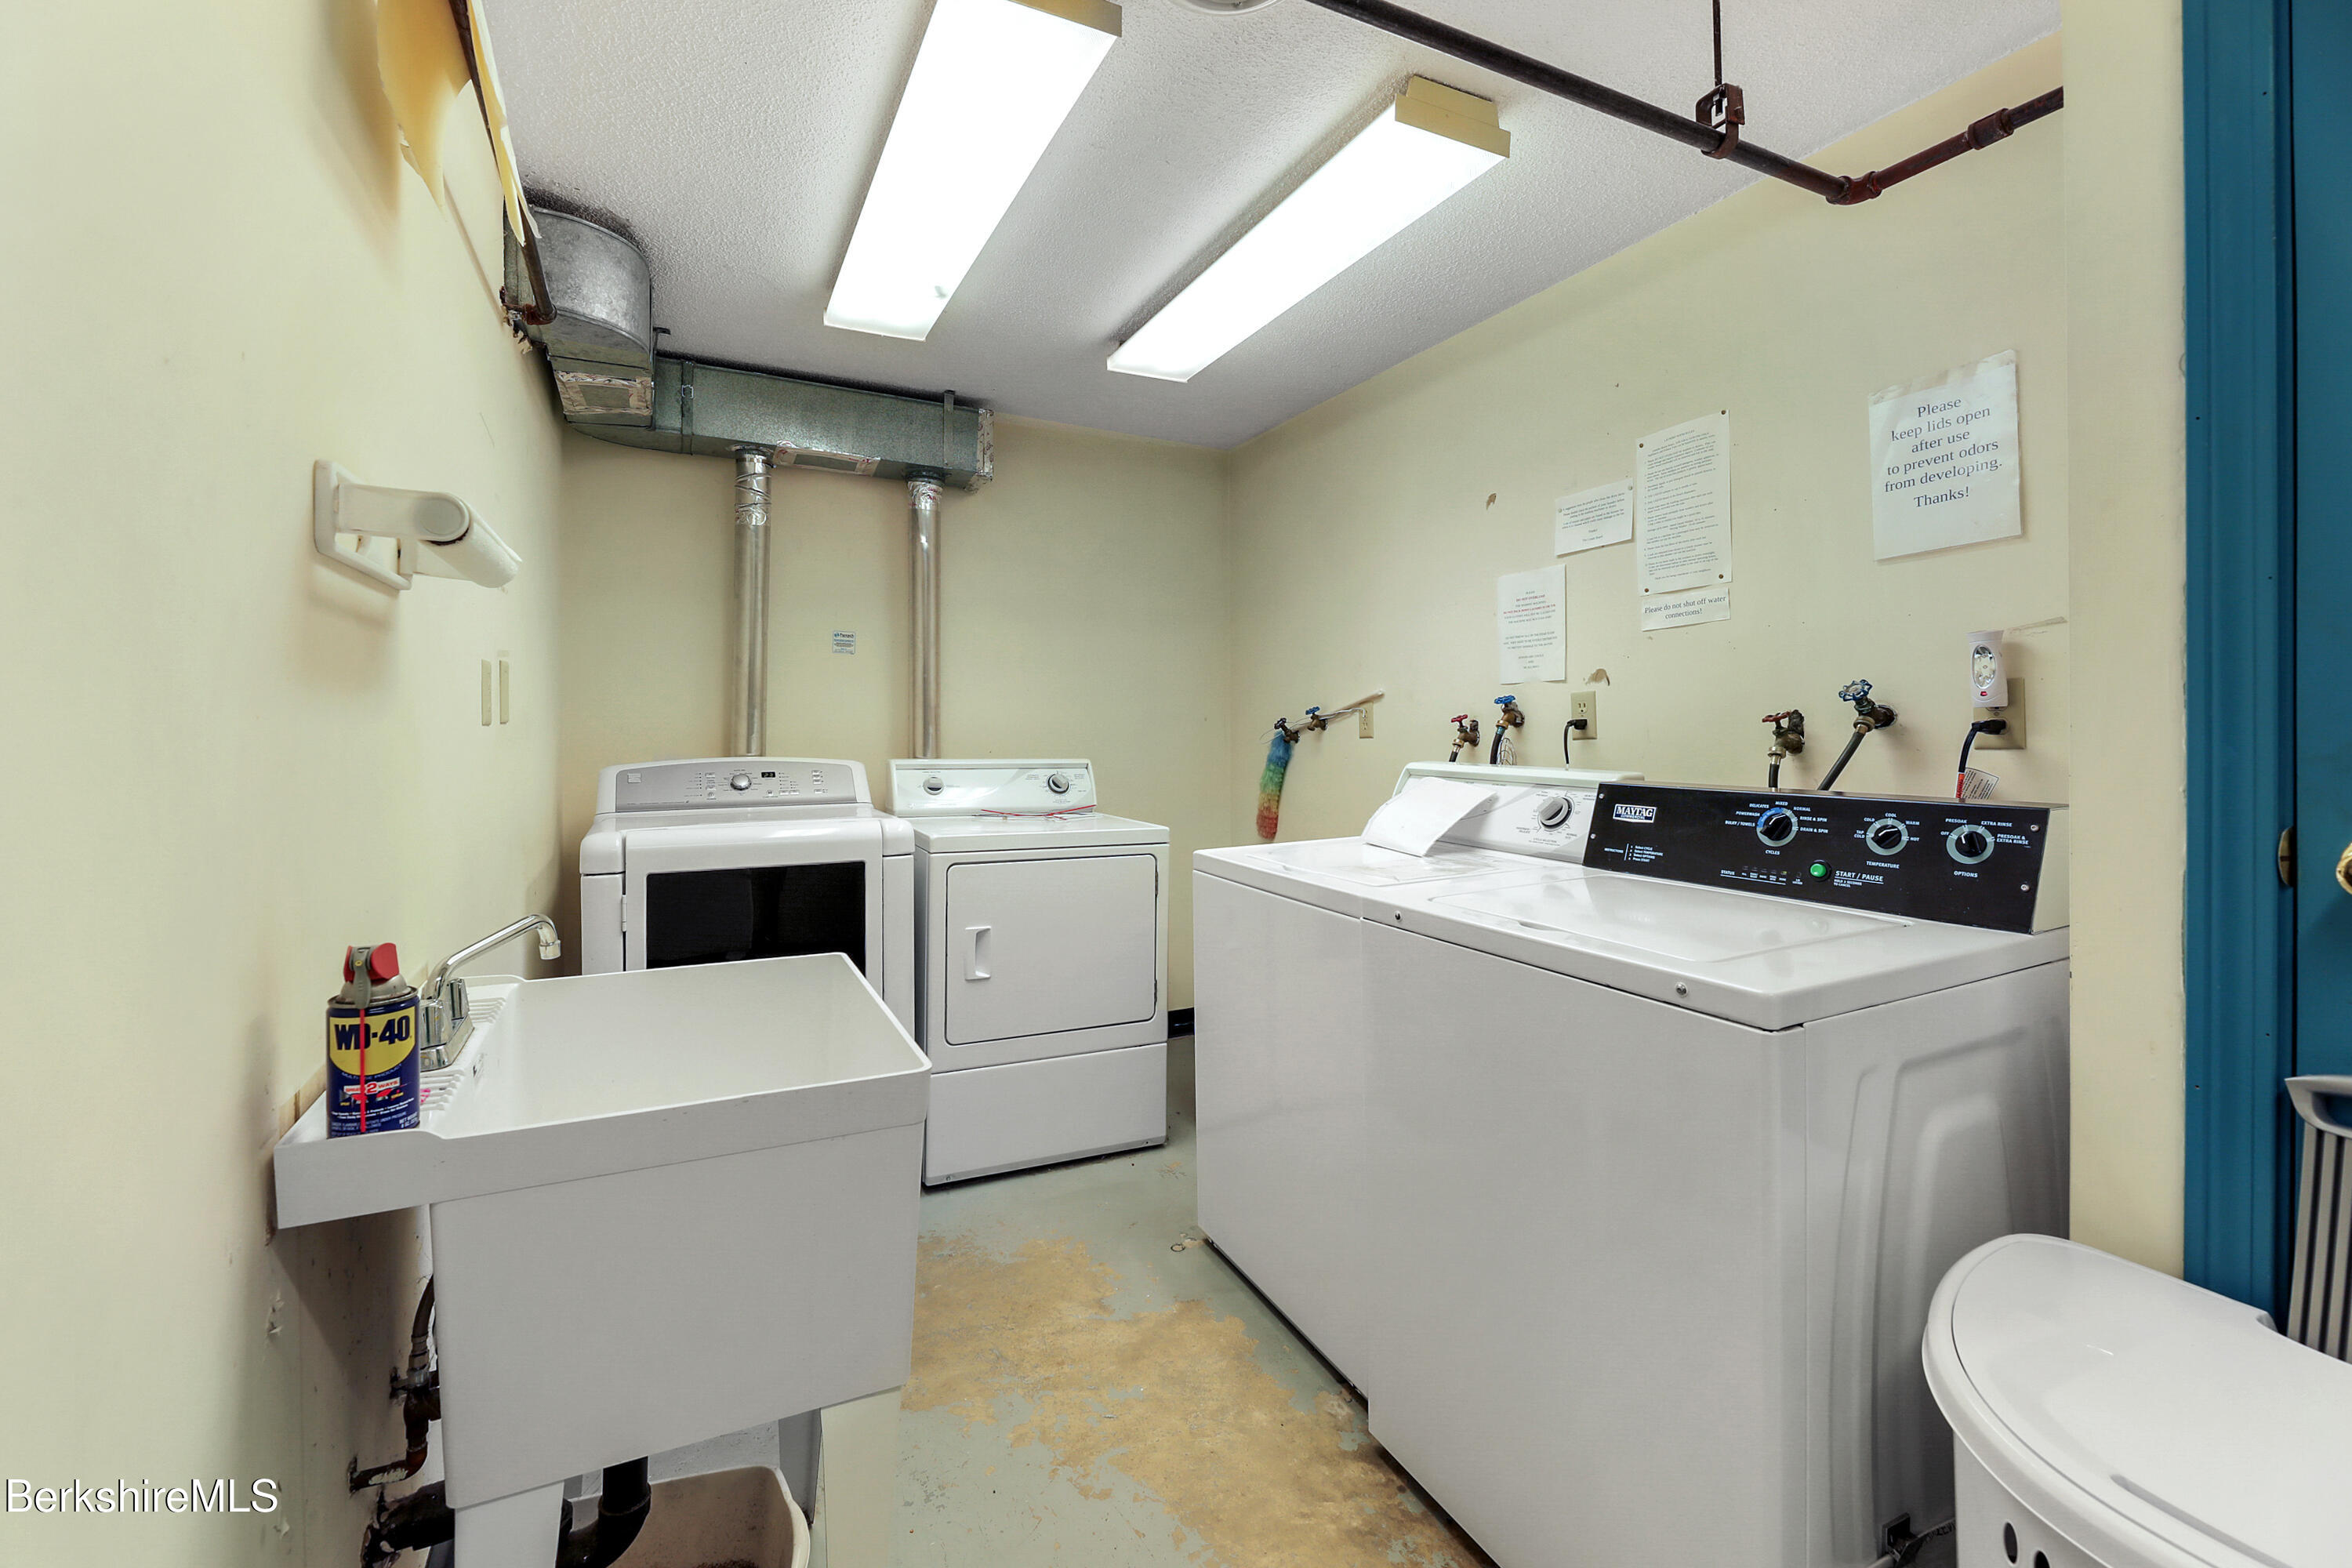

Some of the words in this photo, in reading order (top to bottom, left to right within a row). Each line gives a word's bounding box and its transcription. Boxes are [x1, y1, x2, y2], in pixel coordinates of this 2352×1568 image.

[1918, 398, 1962, 417] Please
[1892, 426, 1922, 441] keep
[1927, 417, 1952, 433] lids
[1956, 408, 1991, 425] open
[1911, 439, 1943, 453] after
[1947, 431, 1970, 445] use
[1887, 466, 1900, 475] to
[1904, 452, 1955, 474] prevent
[1959, 441, 1998, 458] odors
[1885, 477, 1915, 492] from
[1920, 459, 2002, 485] developing.
[1914, 486, 1969, 507] Thanks!
[1665, 608, 1703, 619] connections!
[1617, 806, 1653, 816] MAYTAG
[1861, 873, 1884, 882] PAUSE
[334, 1015, 410, 1051] WD-40
[367, 1082, 377, 1094] 2
